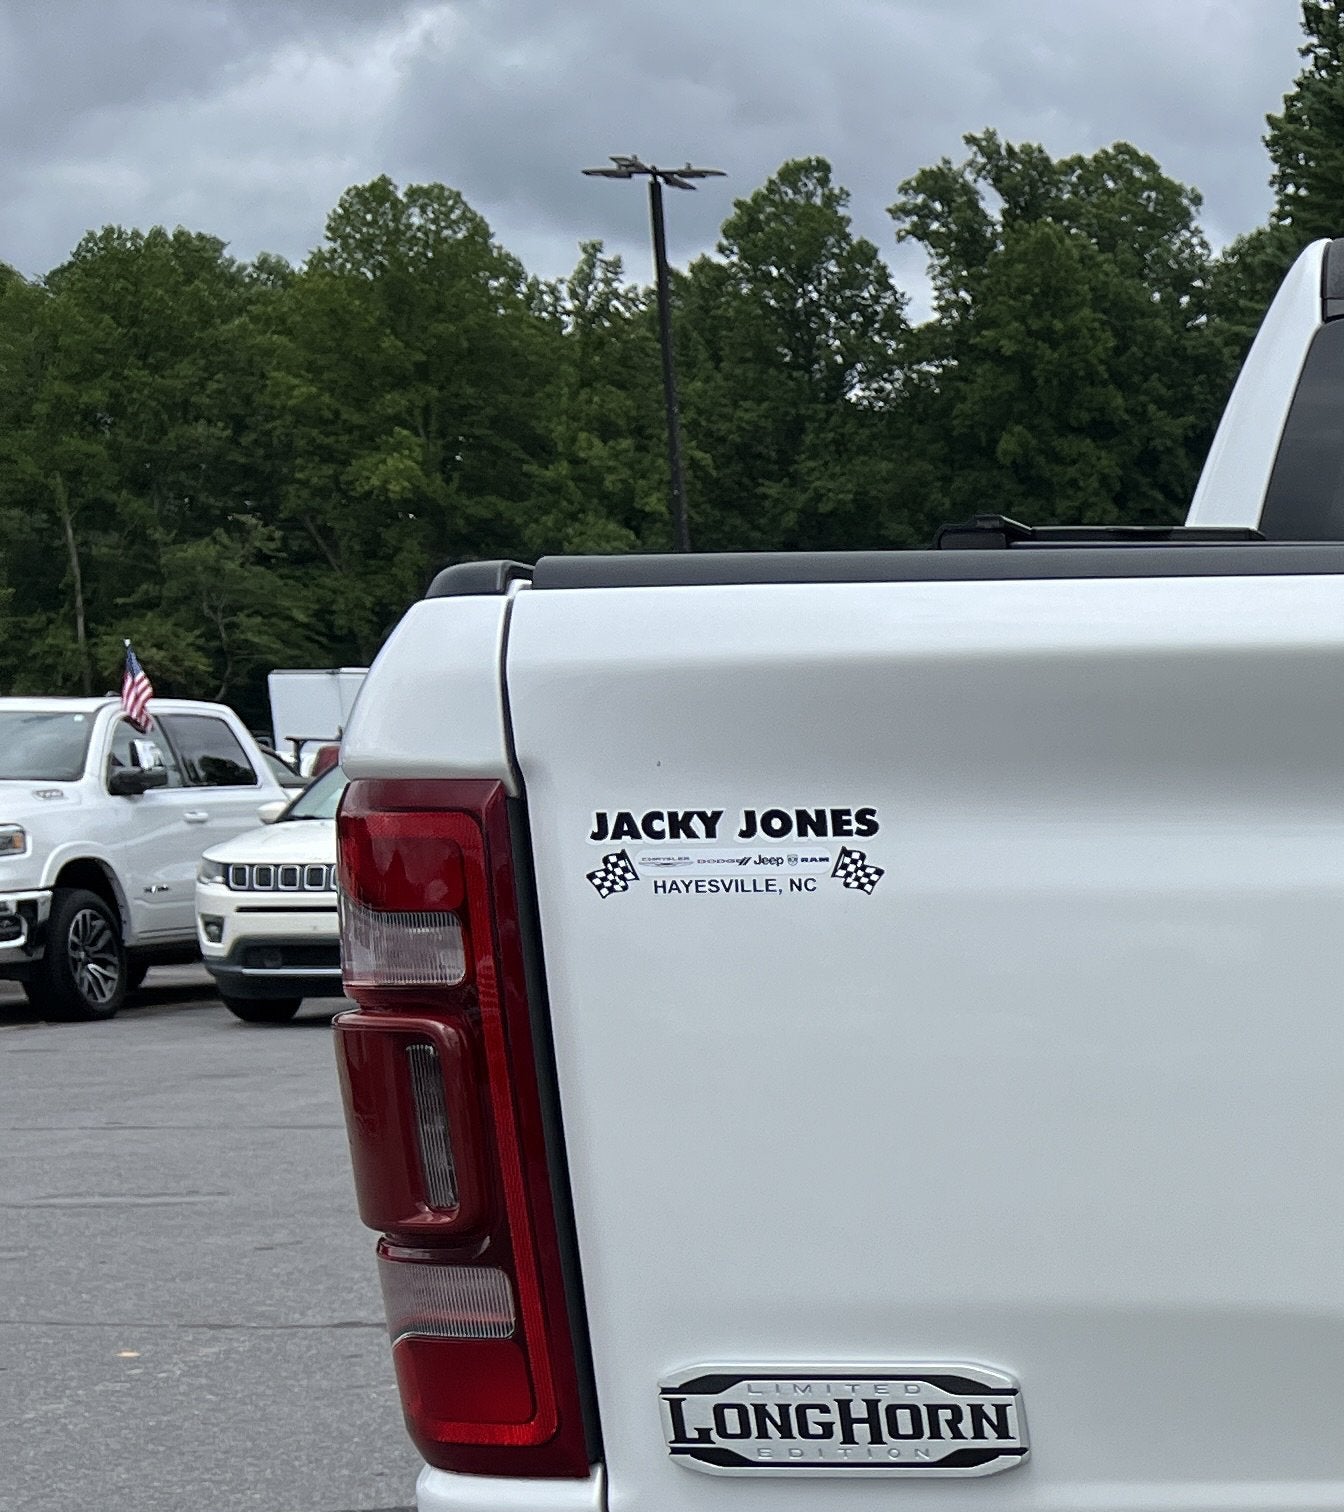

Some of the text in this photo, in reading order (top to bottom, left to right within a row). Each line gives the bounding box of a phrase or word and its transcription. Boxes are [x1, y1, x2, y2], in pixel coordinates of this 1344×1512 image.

[590, 807, 880, 841] JACKY JONES
[754, 854, 785, 867] Jeep
[653, 877, 817, 895] HAYESVILLE, NC
[747, 1383, 922, 1396] LIMITED
[758, 1447, 931, 1460] EDITION
